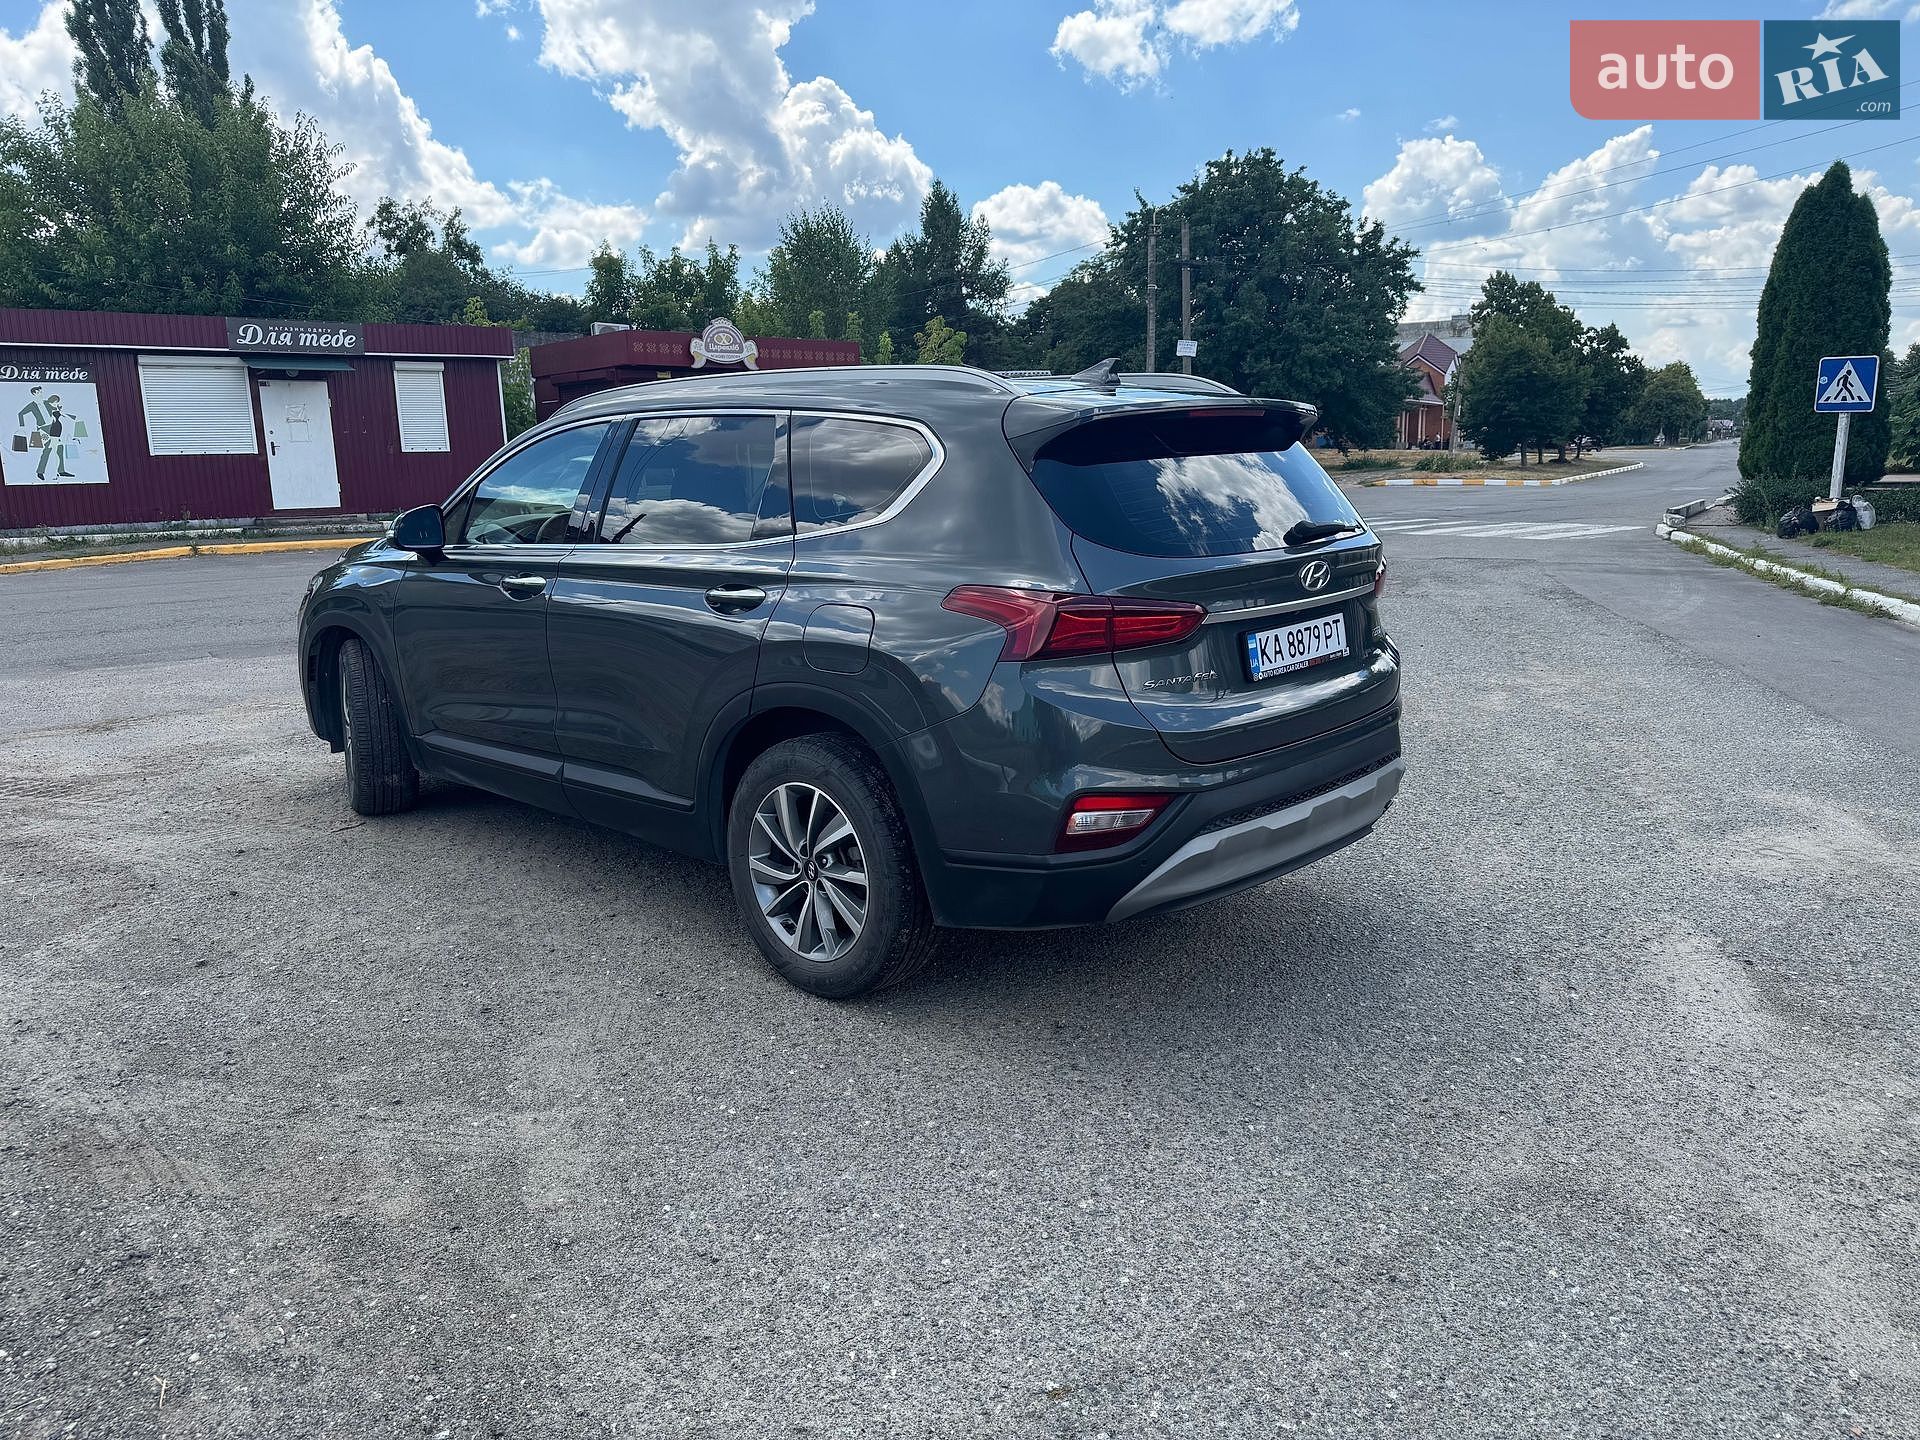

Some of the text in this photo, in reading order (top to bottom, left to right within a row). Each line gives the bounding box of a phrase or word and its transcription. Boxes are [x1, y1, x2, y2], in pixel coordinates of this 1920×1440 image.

[237, 324, 356, 348] Для тебе
[0, 365, 88, 380] Для тебе
[1259, 634, 1284, 666] KA
[1287, 625, 1320, 658] 8879
[1323, 618, 1341, 649] PT
[1250, 658, 1259, 668] UA
[1273, 667, 1287, 676] KOREA
[1287, 664, 1295, 673] CAR
[1295, 660, 1309, 671] DEALER
[1142, 676, 1191, 691] SANTA
